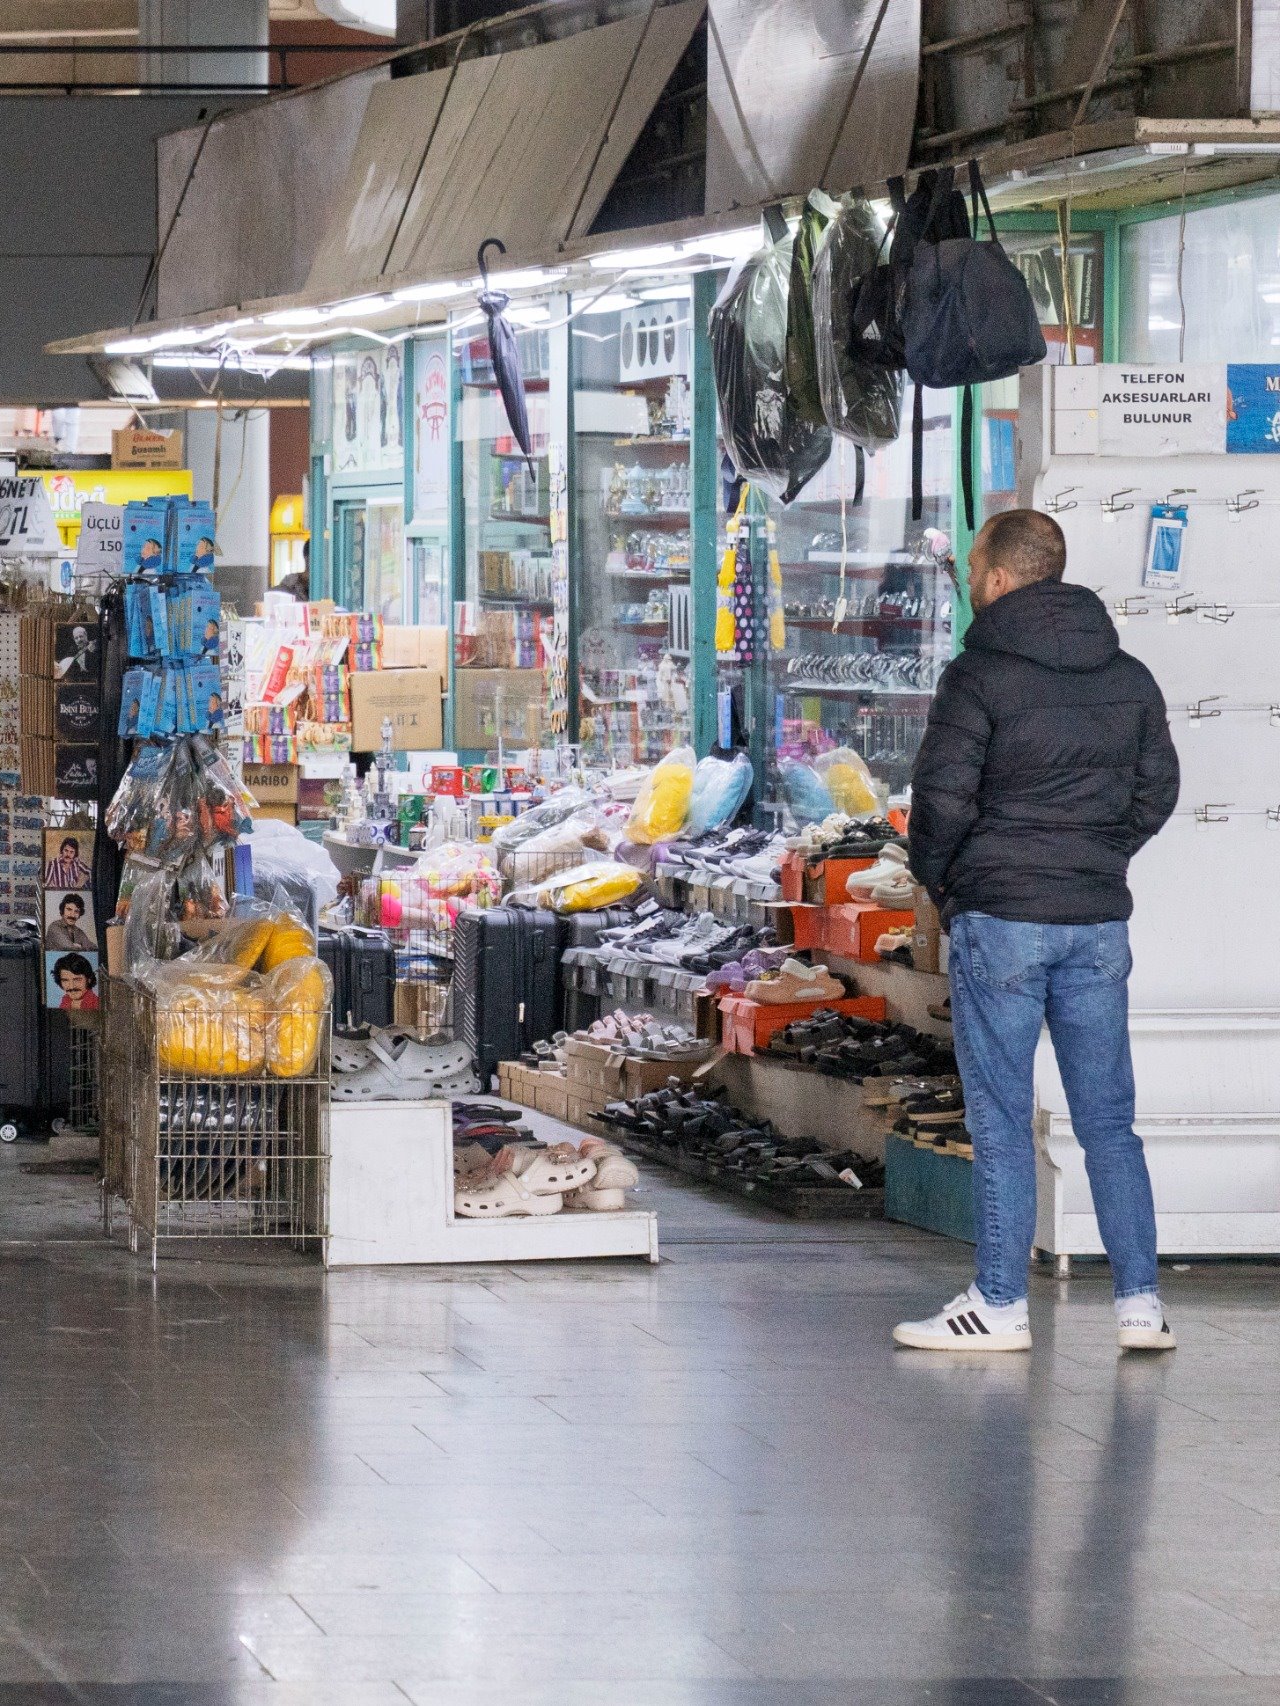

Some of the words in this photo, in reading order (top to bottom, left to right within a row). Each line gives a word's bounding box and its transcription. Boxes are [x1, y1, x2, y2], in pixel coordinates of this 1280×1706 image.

[1121, 373, 1185, 384] TELEFON
[1102, 392, 1211, 403] AKSESUARLARI
[1123, 413, 1192, 424] BULUNUR
[87, 515, 120, 531] ÜÇLÜ
[99, 540, 122, 551] 150
[244, 775, 289, 786] HARIBO
[1120, 1318, 1151, 1328] adidas
